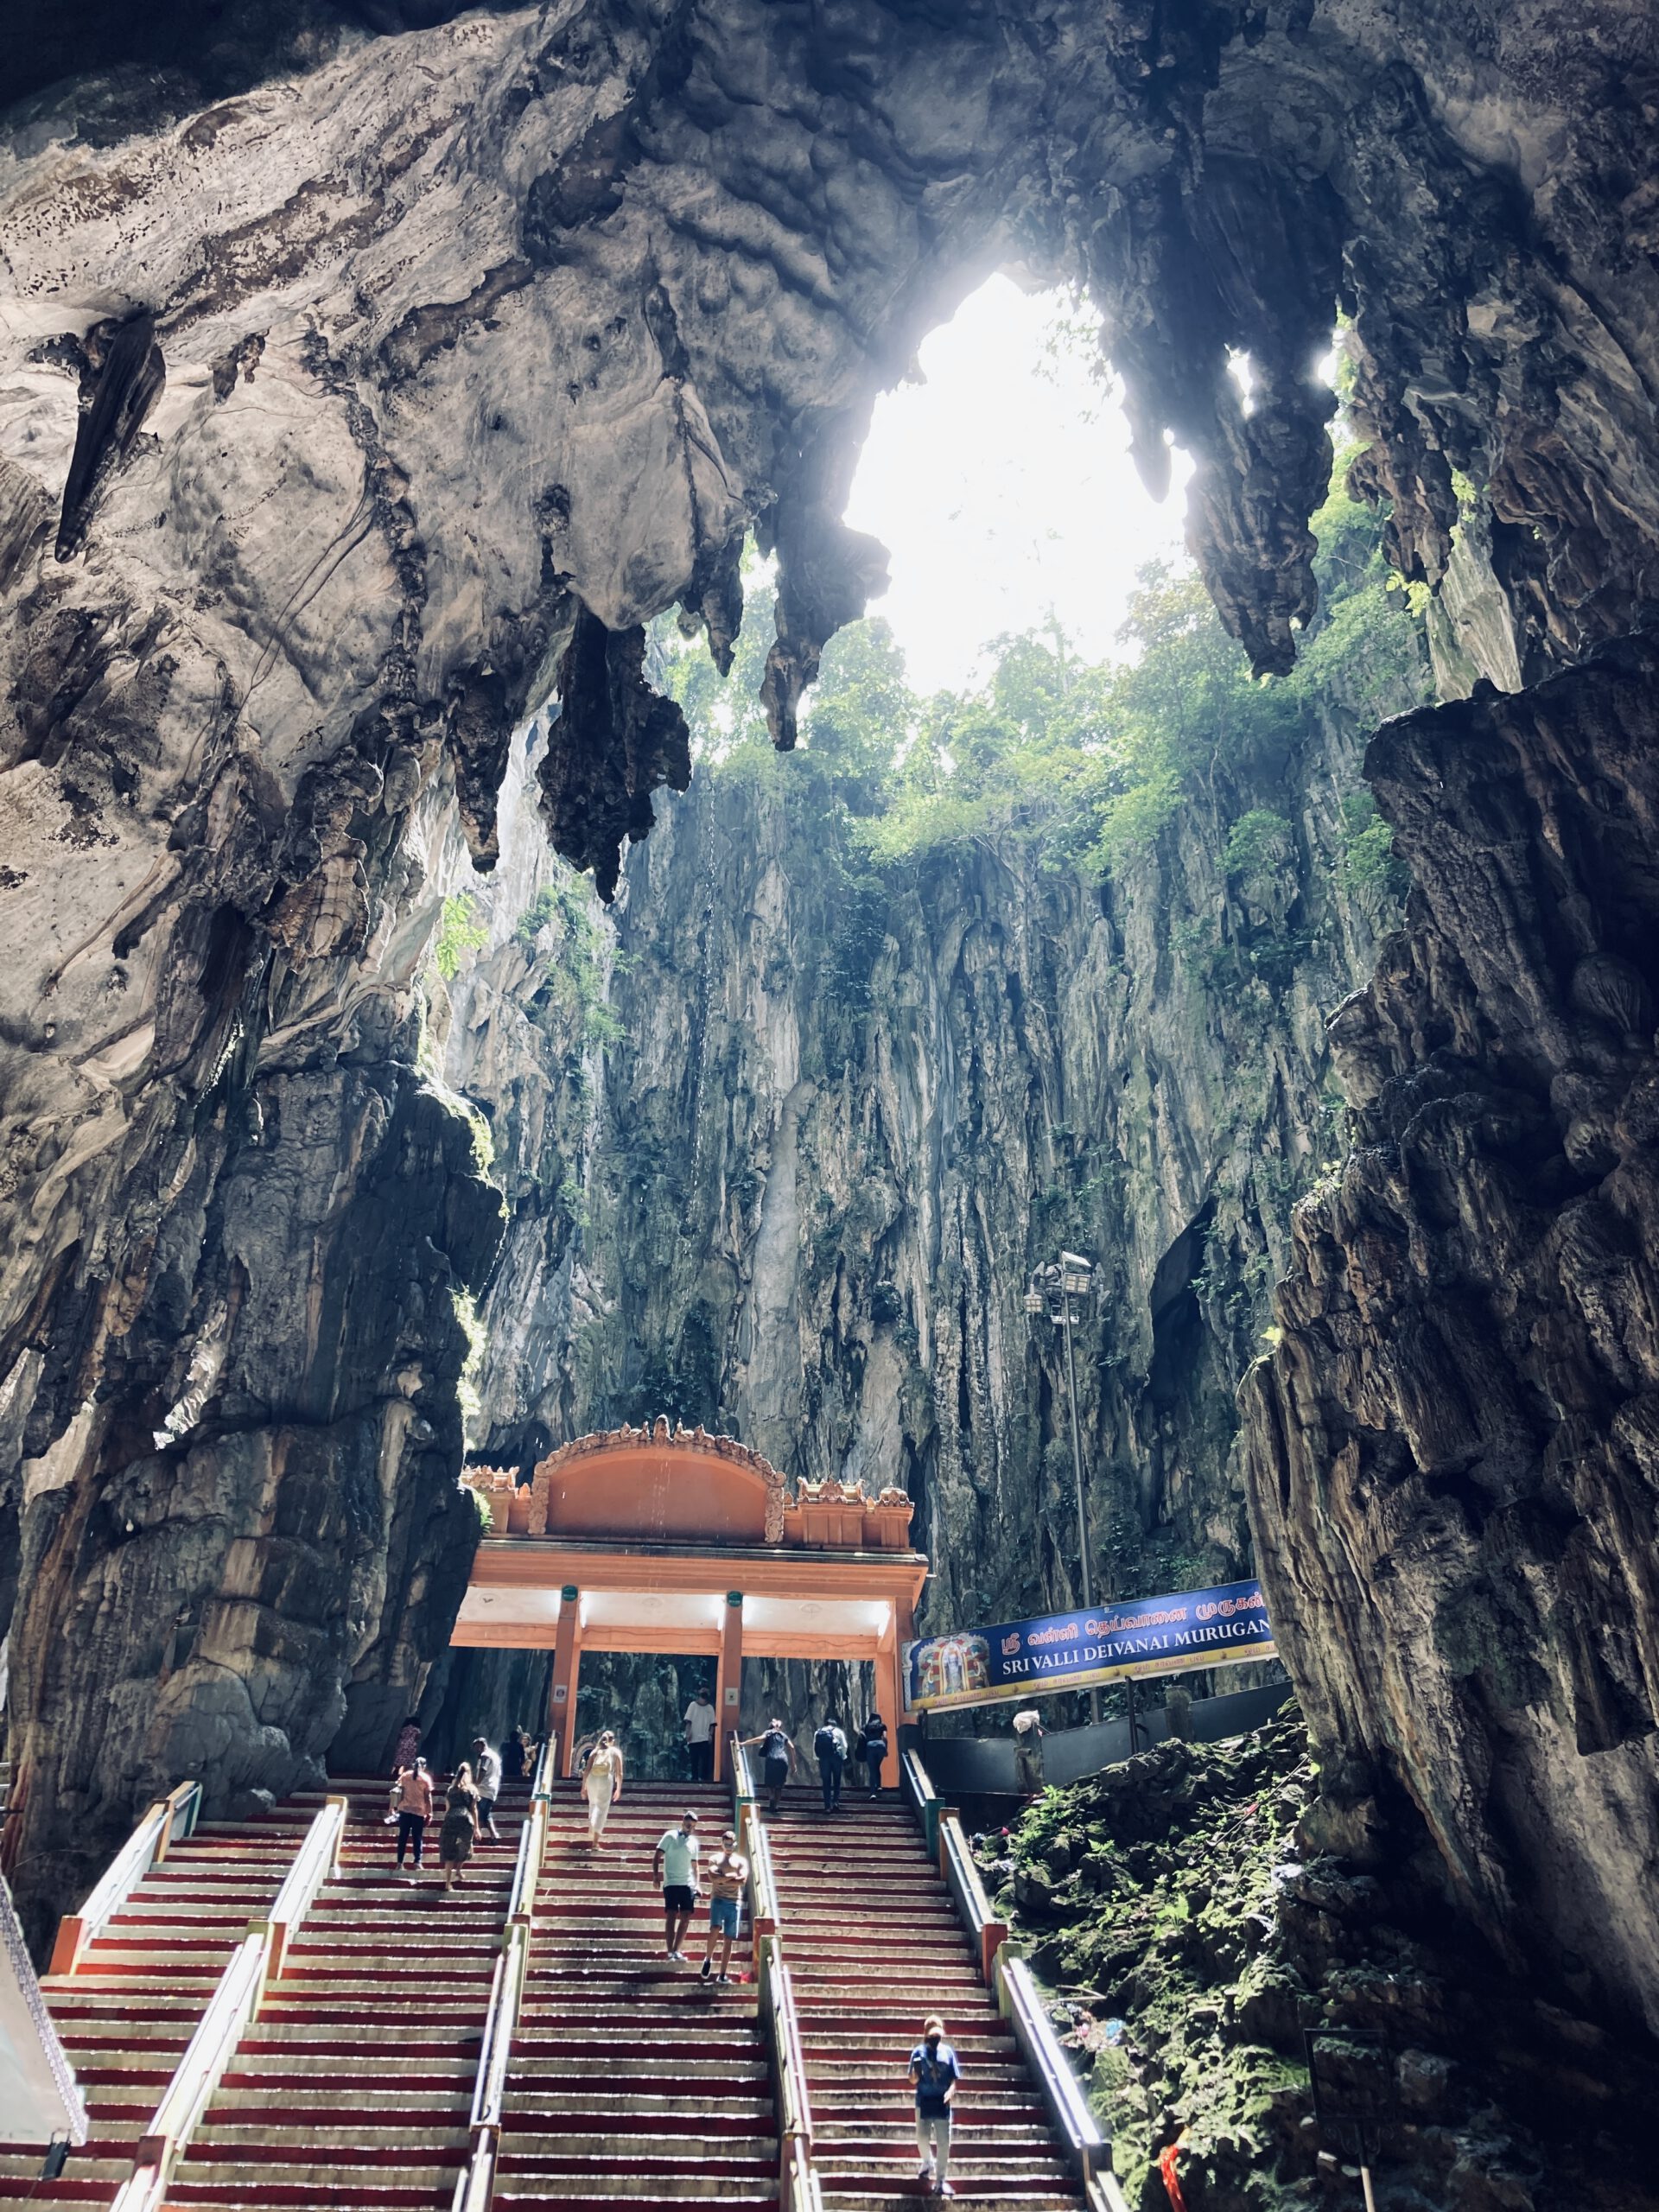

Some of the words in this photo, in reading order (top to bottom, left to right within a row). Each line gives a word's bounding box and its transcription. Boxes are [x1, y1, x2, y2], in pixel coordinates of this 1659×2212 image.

[1001, 1632, 1020, 1656] ஸ்ரீ
[1027, 1623, 1078, 1646] வள்ளி
[1085, 1607, 1187, 1638] தெய்வானை
[1196, 1592, 1266, 1620] முருகன்
[1002, 1658, 1030, 1675] SRI
[1031, 1649, 1079, 1669] VALLI
[1084, 1635, 1169, 1662] DEIVANAI
[1175, 1618, 1270, 1647] MURUGAN
